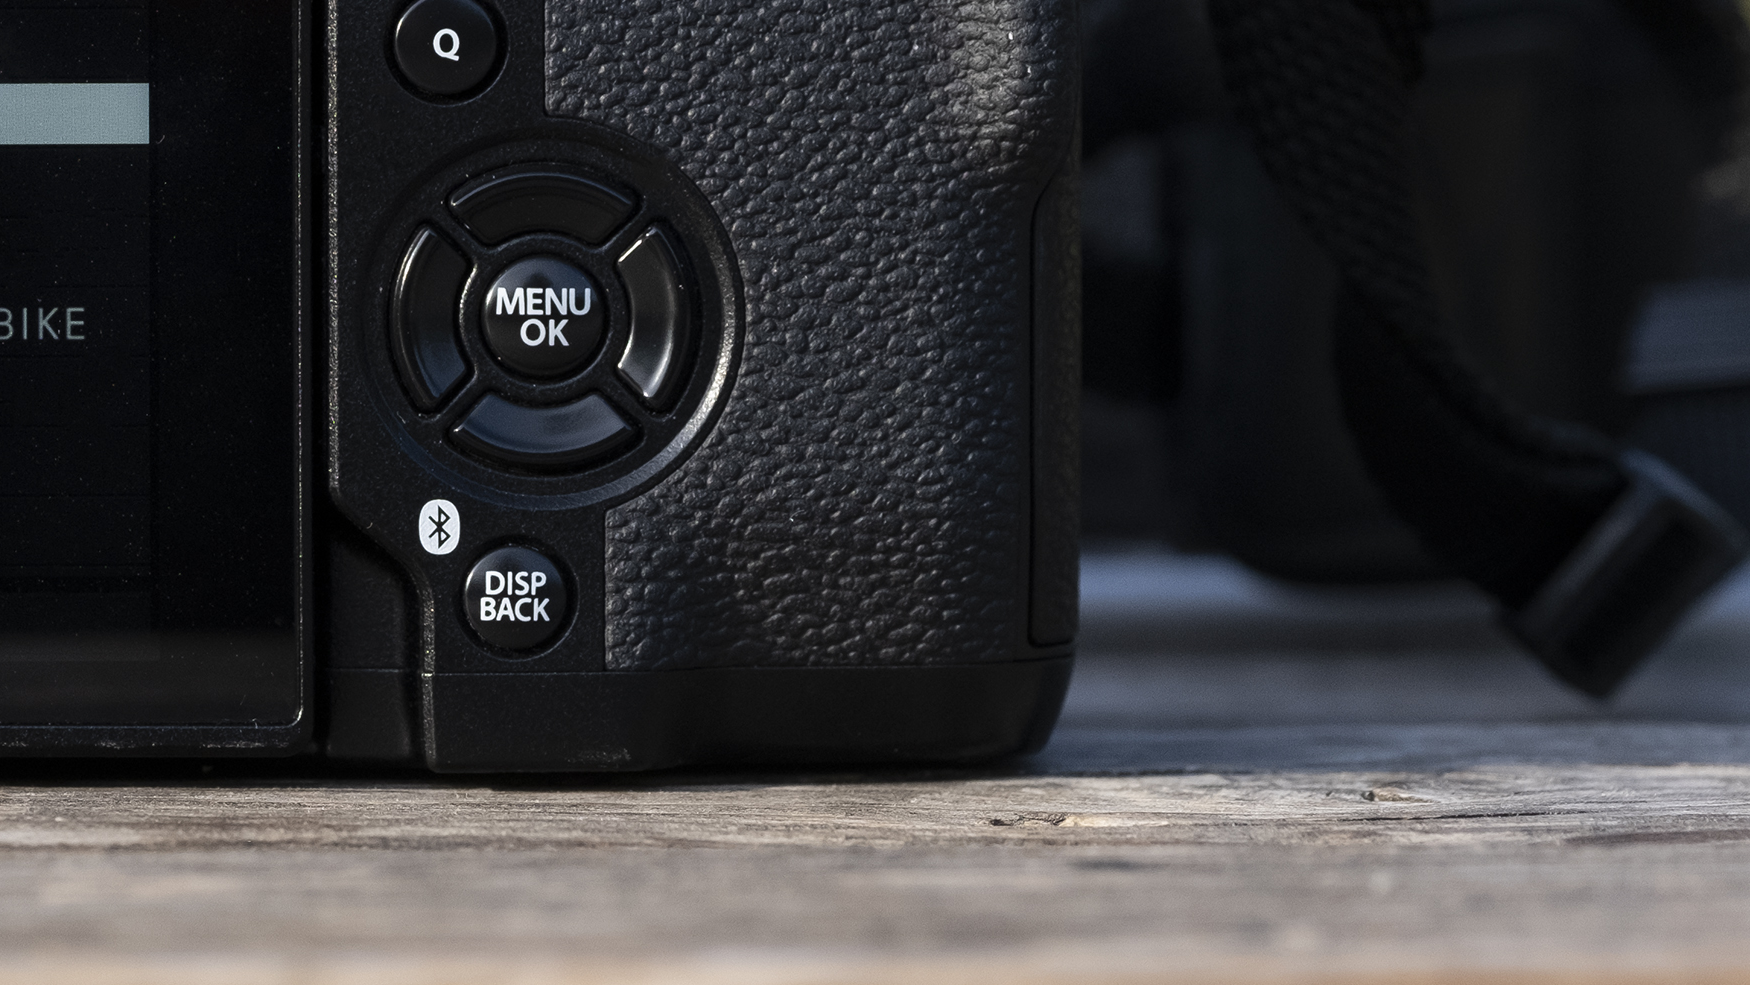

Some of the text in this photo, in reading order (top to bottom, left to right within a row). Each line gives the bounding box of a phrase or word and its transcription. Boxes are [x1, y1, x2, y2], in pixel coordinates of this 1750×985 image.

[432, 27, 461, 62] Q
[494, 286, 592, 316] MENU
[519, 318, 570, 348] OK
[484, 570, 548, 595] DISP
[479, 596, 551, 623] BACK
